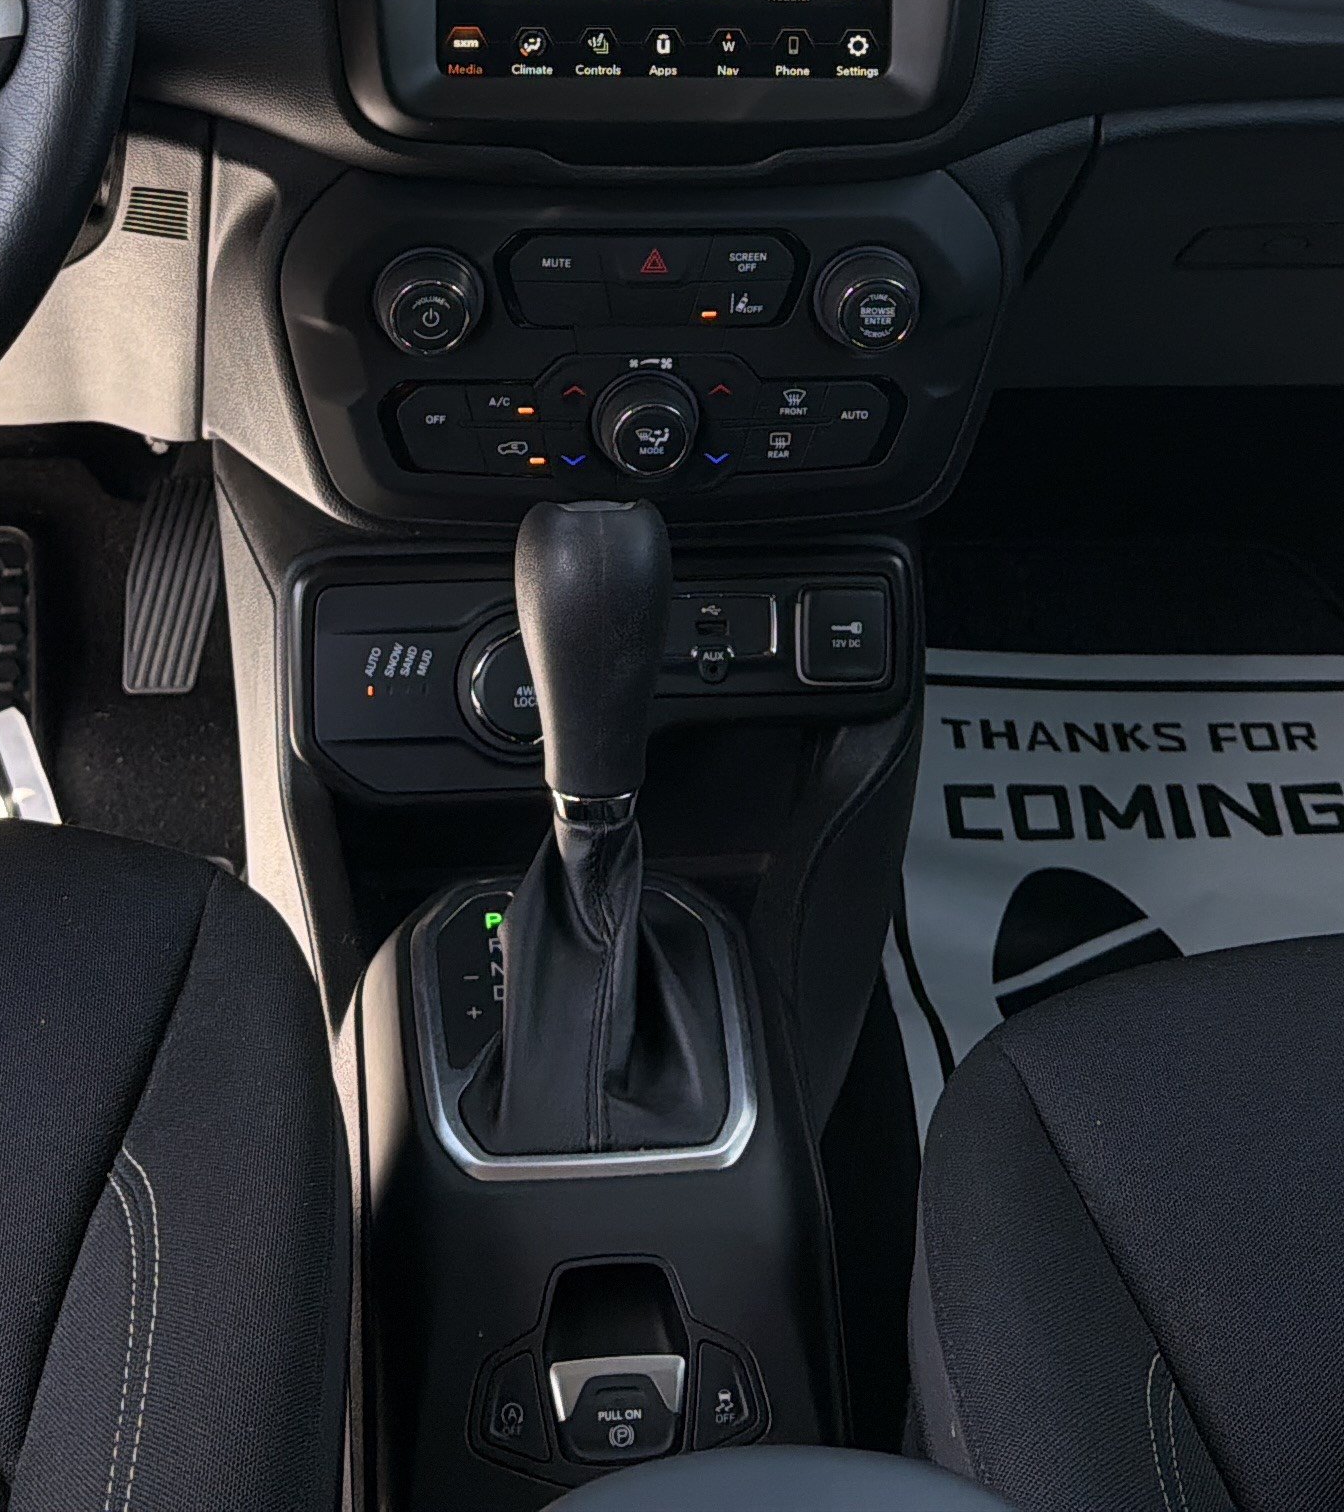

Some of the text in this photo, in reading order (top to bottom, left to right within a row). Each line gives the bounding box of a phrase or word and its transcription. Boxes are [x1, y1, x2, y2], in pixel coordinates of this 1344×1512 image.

[448, 65, 483, 75] Media
[511, 64, 553, 75] Climate
[575, 64, 621, 75] Controls
[649, 65, 678, 77] Apps
[717, 65, 739, 76] Nav
[775, 65, 810, 76] Phone
[836, 65, 879, 78] Settings
[729, 252, 767, 262] SCREEN
[541, 257, 572, 269] MUTE
[737, 263, 757, 273] OFF
[869, 293, 889, 302] TUNE
[747, 305, 764, 314] OFF
[860, 307, 895, 315] BROWSE
[864, 317, 891, 325] ENTER
[488, 396, 511, 407] A/C
[779, 407, 808, 416] FRONT
[840, 410, 869, 420] AUTO
[425, 414, 447, 425] OFF
[639, 446, 665, 455] MODE
[767, 450, 790, 459] REAR
[831, 639, 861, 648] 12V DC
[383, 641, 404, 678] SNOW
[399, 645, 418, 678] SAND
[702, 651, 725, 661] AUX
[364, 646, 382, 678] AUTO
[416, 648, 433, 677] MUD
[516, 686, 536, 696] 4W
[514, 697, 538, 708] LOC
[941, 716, 1319, 754] THANKS FOR
[485, 912, 502, 930] P
[597, 1409, 642, 1422] PULL ON
[715, 1413, 736, 1424] OFF
